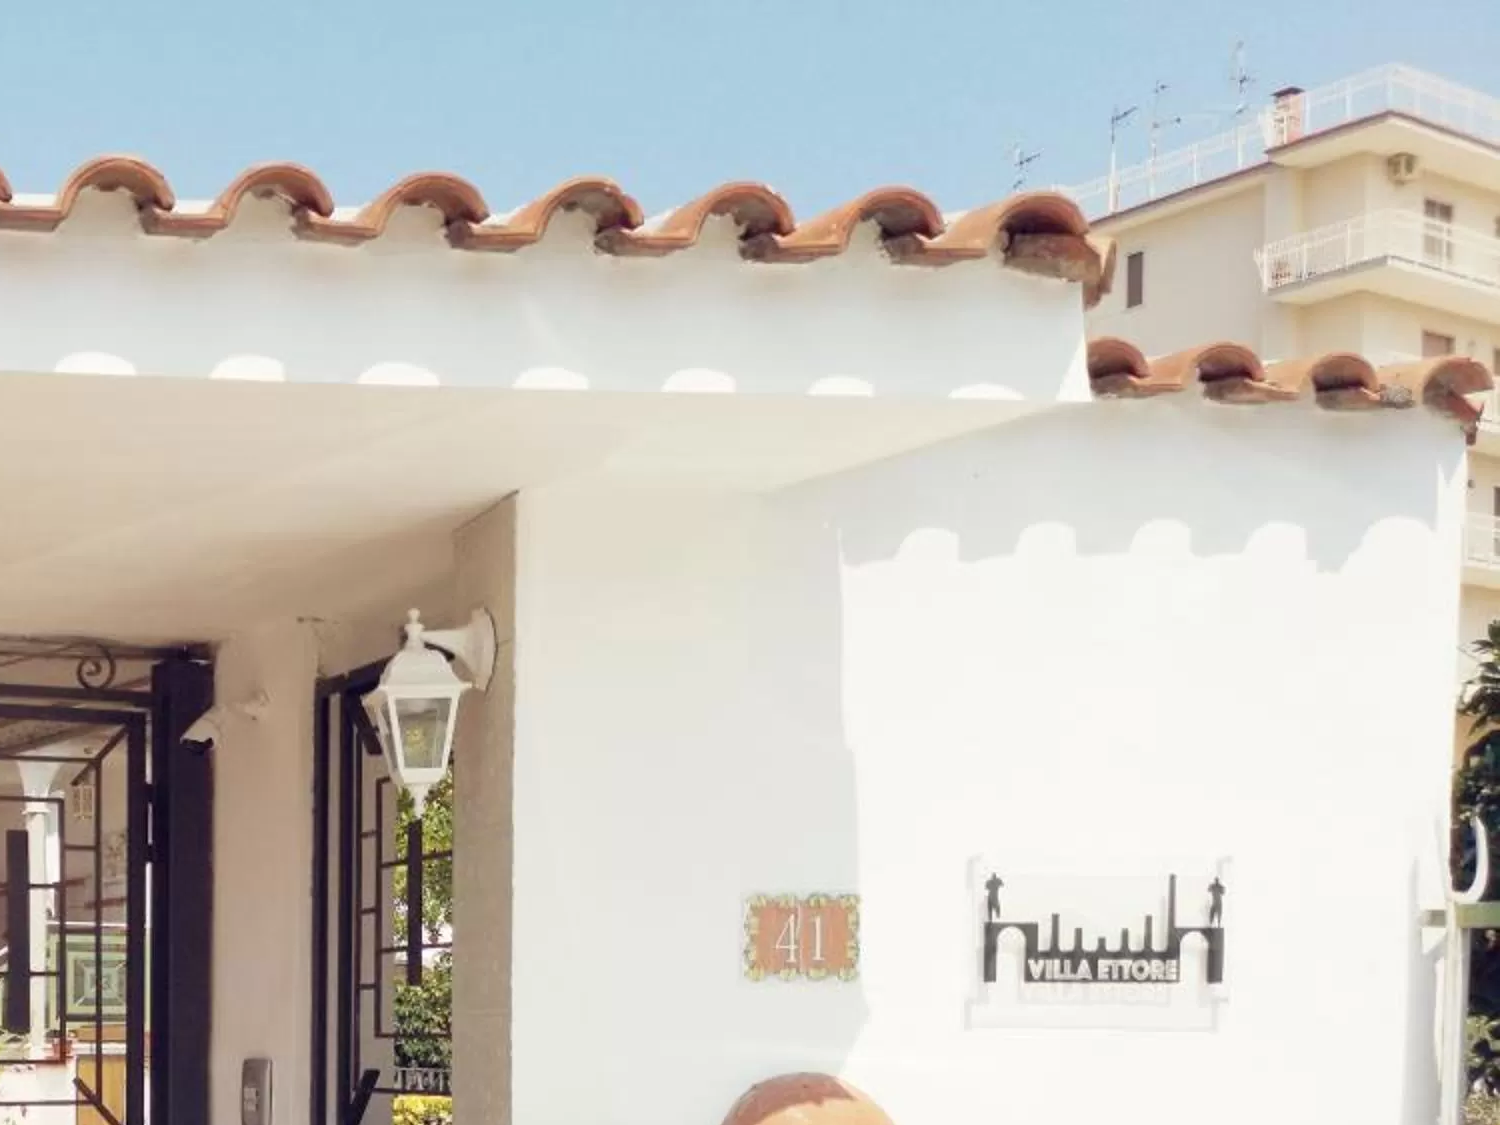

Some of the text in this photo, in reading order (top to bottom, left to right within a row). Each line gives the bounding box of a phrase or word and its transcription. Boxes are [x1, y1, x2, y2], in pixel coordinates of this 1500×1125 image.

[775, 913, 826, 963] 41
[1027, 959, 1178, 980] VILLA ETTORE
